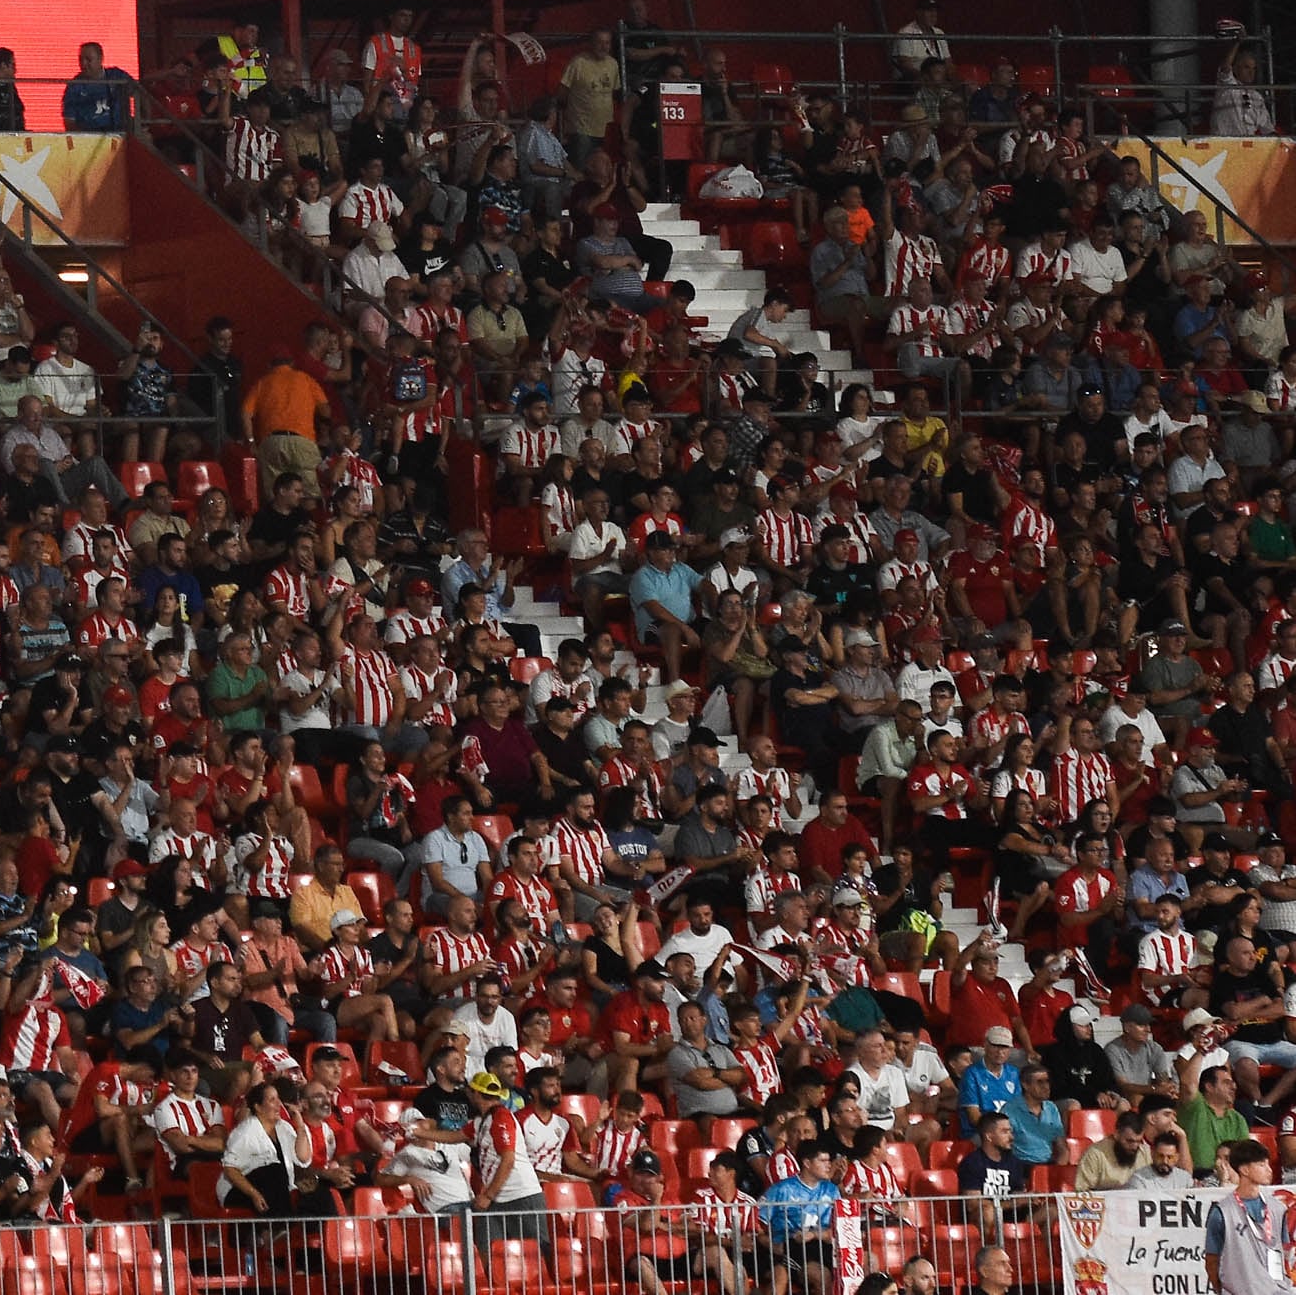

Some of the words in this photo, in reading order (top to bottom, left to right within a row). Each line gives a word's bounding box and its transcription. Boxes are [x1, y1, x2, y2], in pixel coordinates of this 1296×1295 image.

[663, 107, 685, 120] 133
[984, 1167, 1010, 1186] JUST
[1138, 1194, 1218, 1228] PEÑ
[1126, 1236, 1147, 1265] La
[1152, 1274, 1189, 1295] CON
